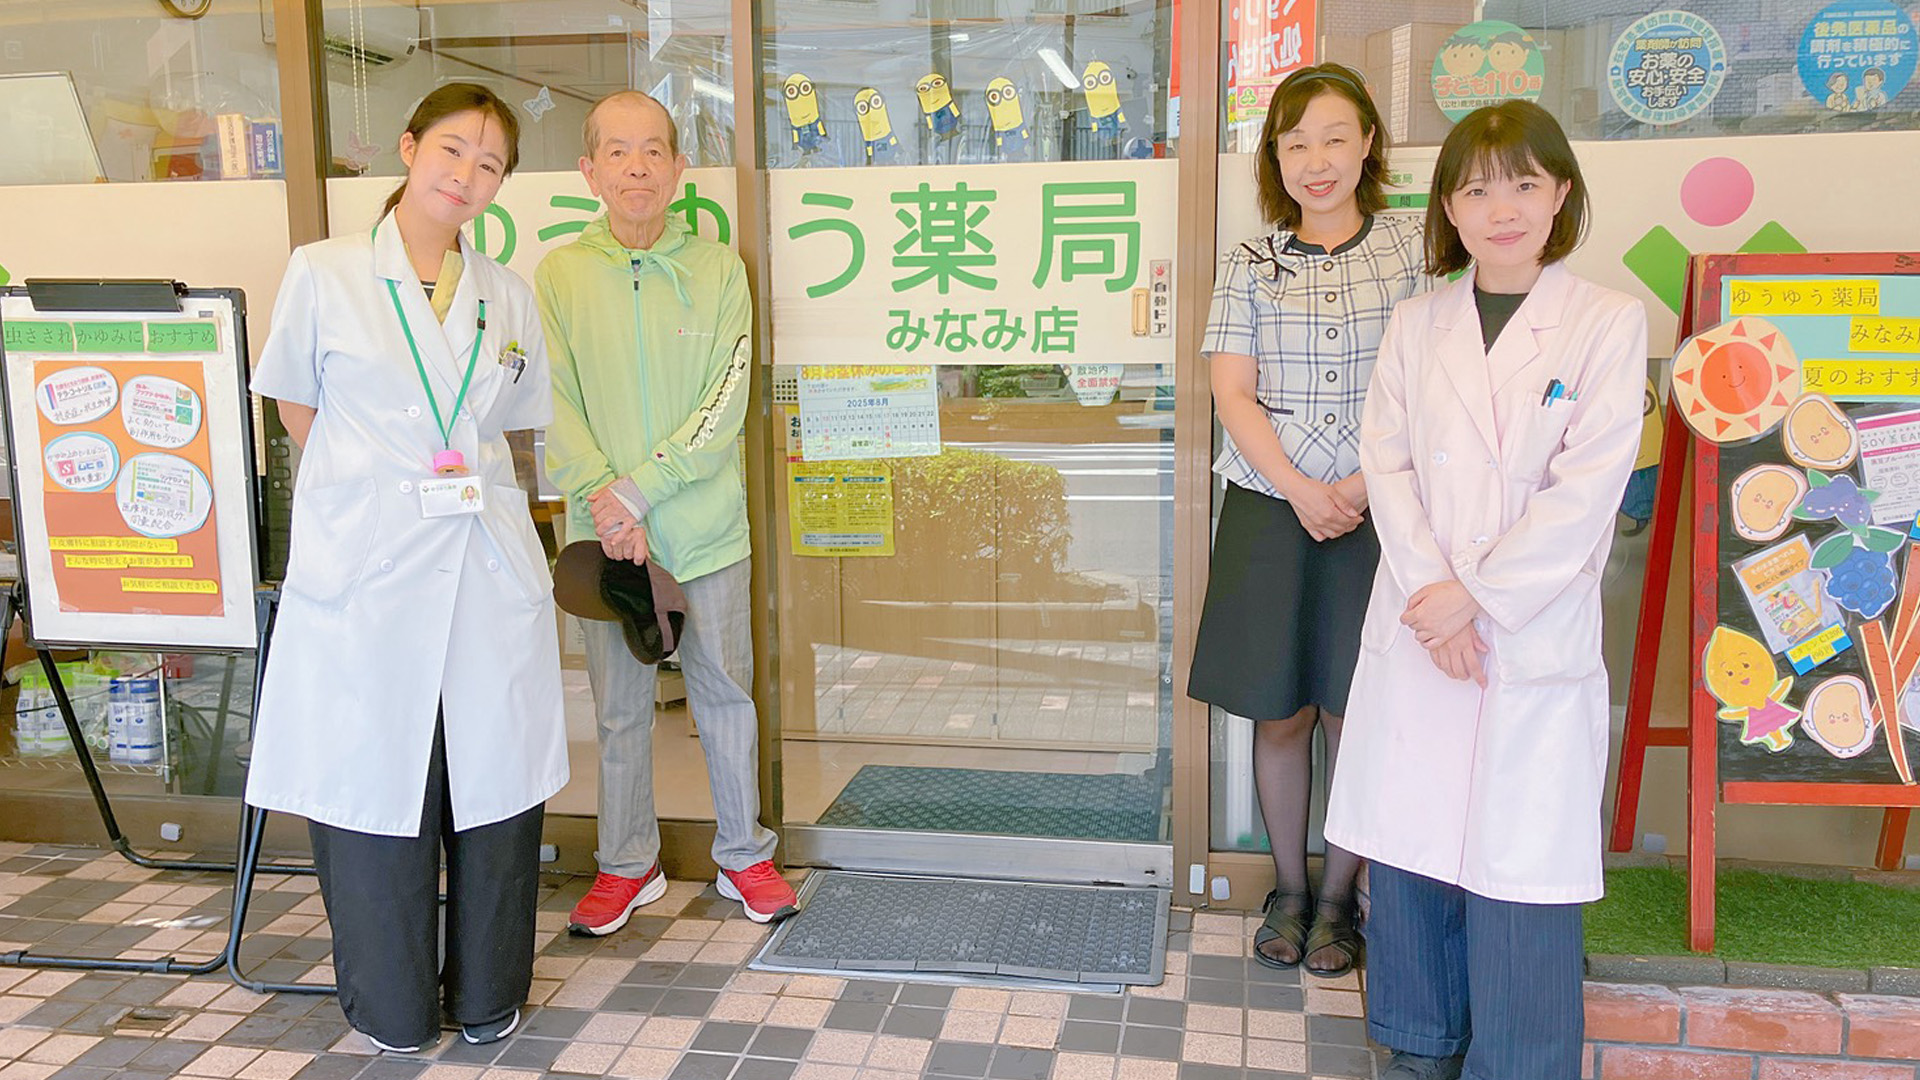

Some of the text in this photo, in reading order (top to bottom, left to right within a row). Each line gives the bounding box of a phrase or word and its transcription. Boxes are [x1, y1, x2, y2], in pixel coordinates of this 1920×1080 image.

[1814, 19, 1910, 37] 後発医薬品の
[1641, 52, 1694, 69] お薬の
[1817, 53, 1902, 68] 行っています
[1627, 67, 1706, 87] 安心・安全
[1641, 86, 1688, 98] お手伝い
[1647, 97, 1680, 108] します
[1732, 287, 1878, 308] ゆうゆう薬局
[885, 306, 1079, 354] みなみ店
[1851, 323, 1920, 345] みなみ
[847, 397, 889, 408] 2025年8月
